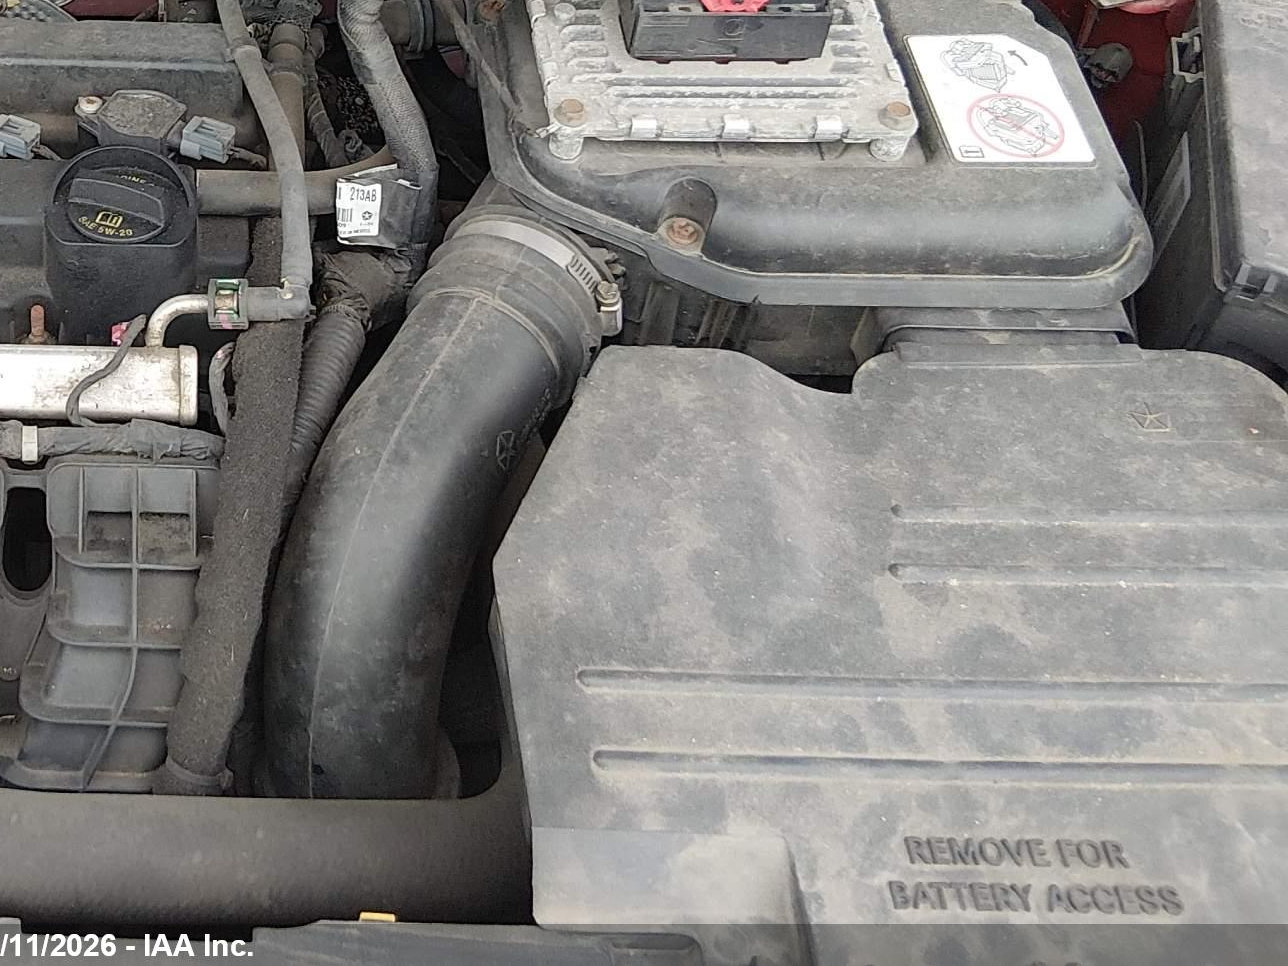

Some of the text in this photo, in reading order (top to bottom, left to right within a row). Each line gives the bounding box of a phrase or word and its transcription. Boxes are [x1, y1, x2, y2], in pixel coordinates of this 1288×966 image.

[350, 186, 377, 202] 213AB
[78, 216, 134, 237] SAE 5W-20
[903, 835, 1130, 869] REMOVE FOR
[888, 880, 1184, 916] BATTERY ACCESS
